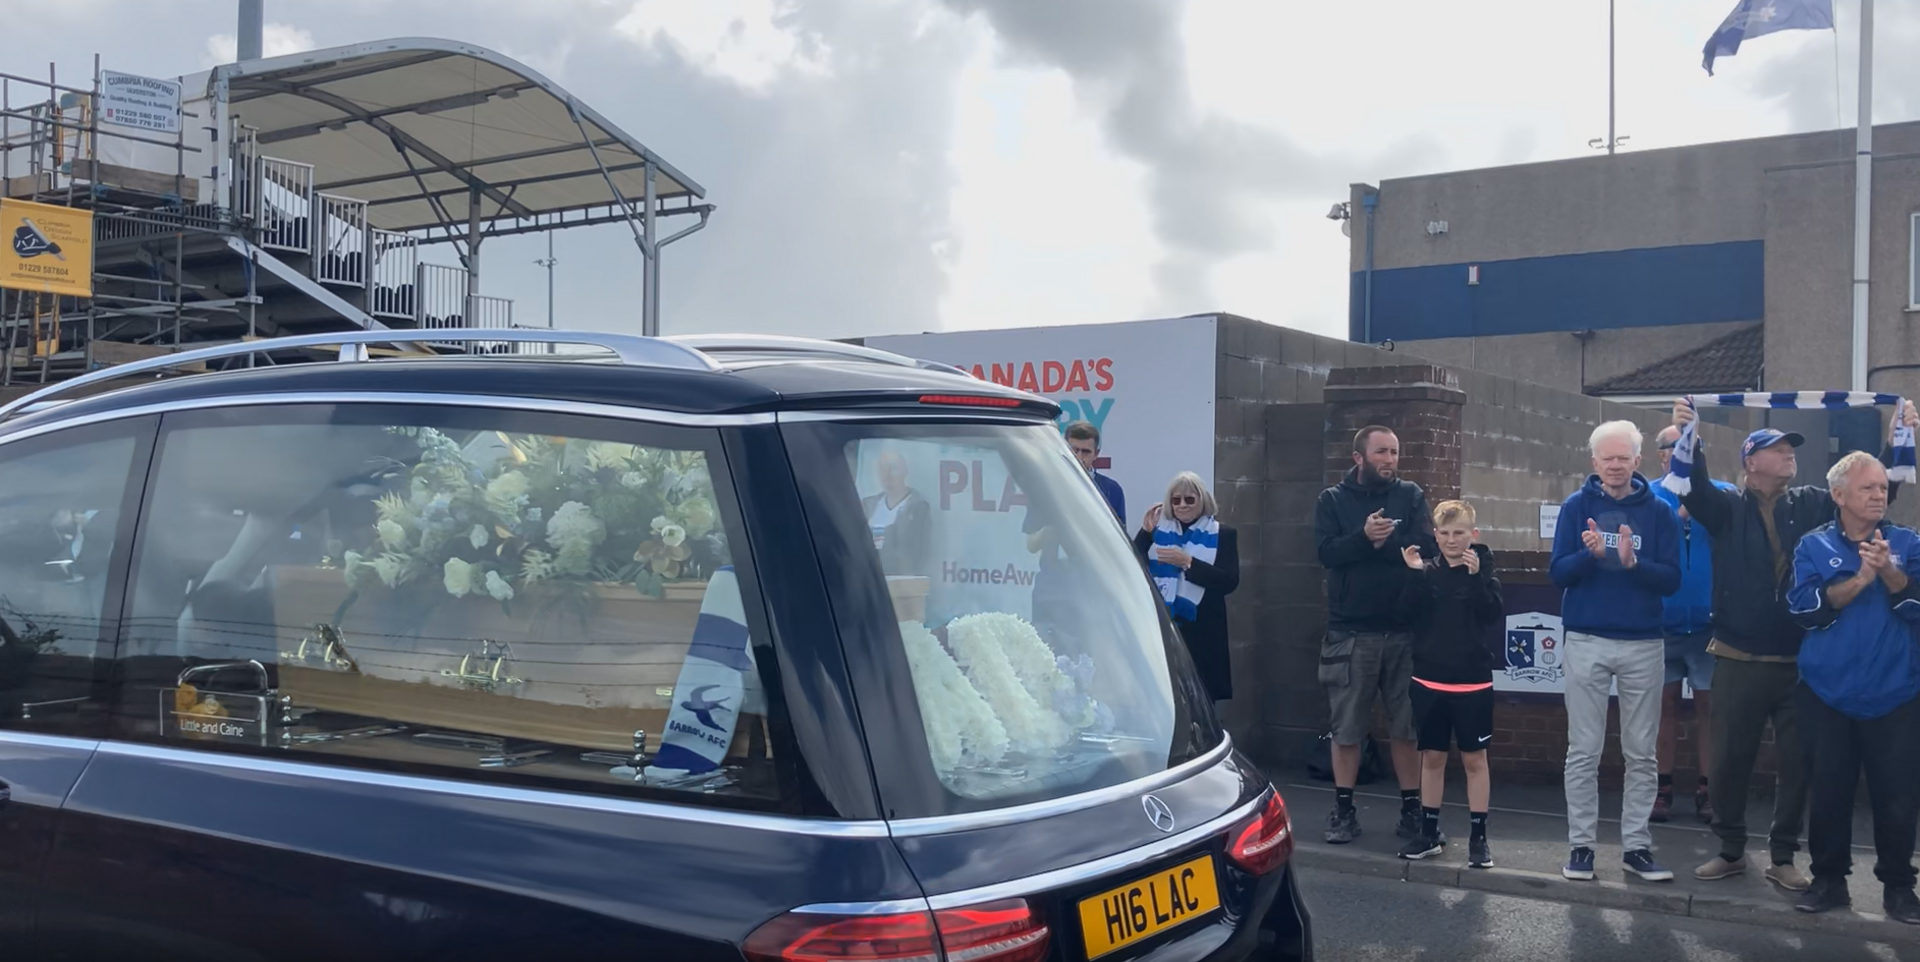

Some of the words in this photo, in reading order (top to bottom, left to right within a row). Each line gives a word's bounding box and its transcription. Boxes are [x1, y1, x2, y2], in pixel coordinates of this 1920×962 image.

[107, 76, 142, 87] CUMBRIA
[143, 79, 174, 96] ROOFING
[115, 108, 137, 117] 01229
[19, 263, 41, 272] 01229
[954, 358, 1114, 393] ANADA'S
[942, 560, 1036, 587] HomeAw
[1514, 668, 1540, 677] BARROW
[180, 719, 200, 732] Little
[202, 723, 218, 734] and
[219, 723, 244, 737] Caine
[669, 720, 706, 738] BARROW
[1103, 887, 1147, 945] H16
[1149, 867, 1199, 926] LAC
